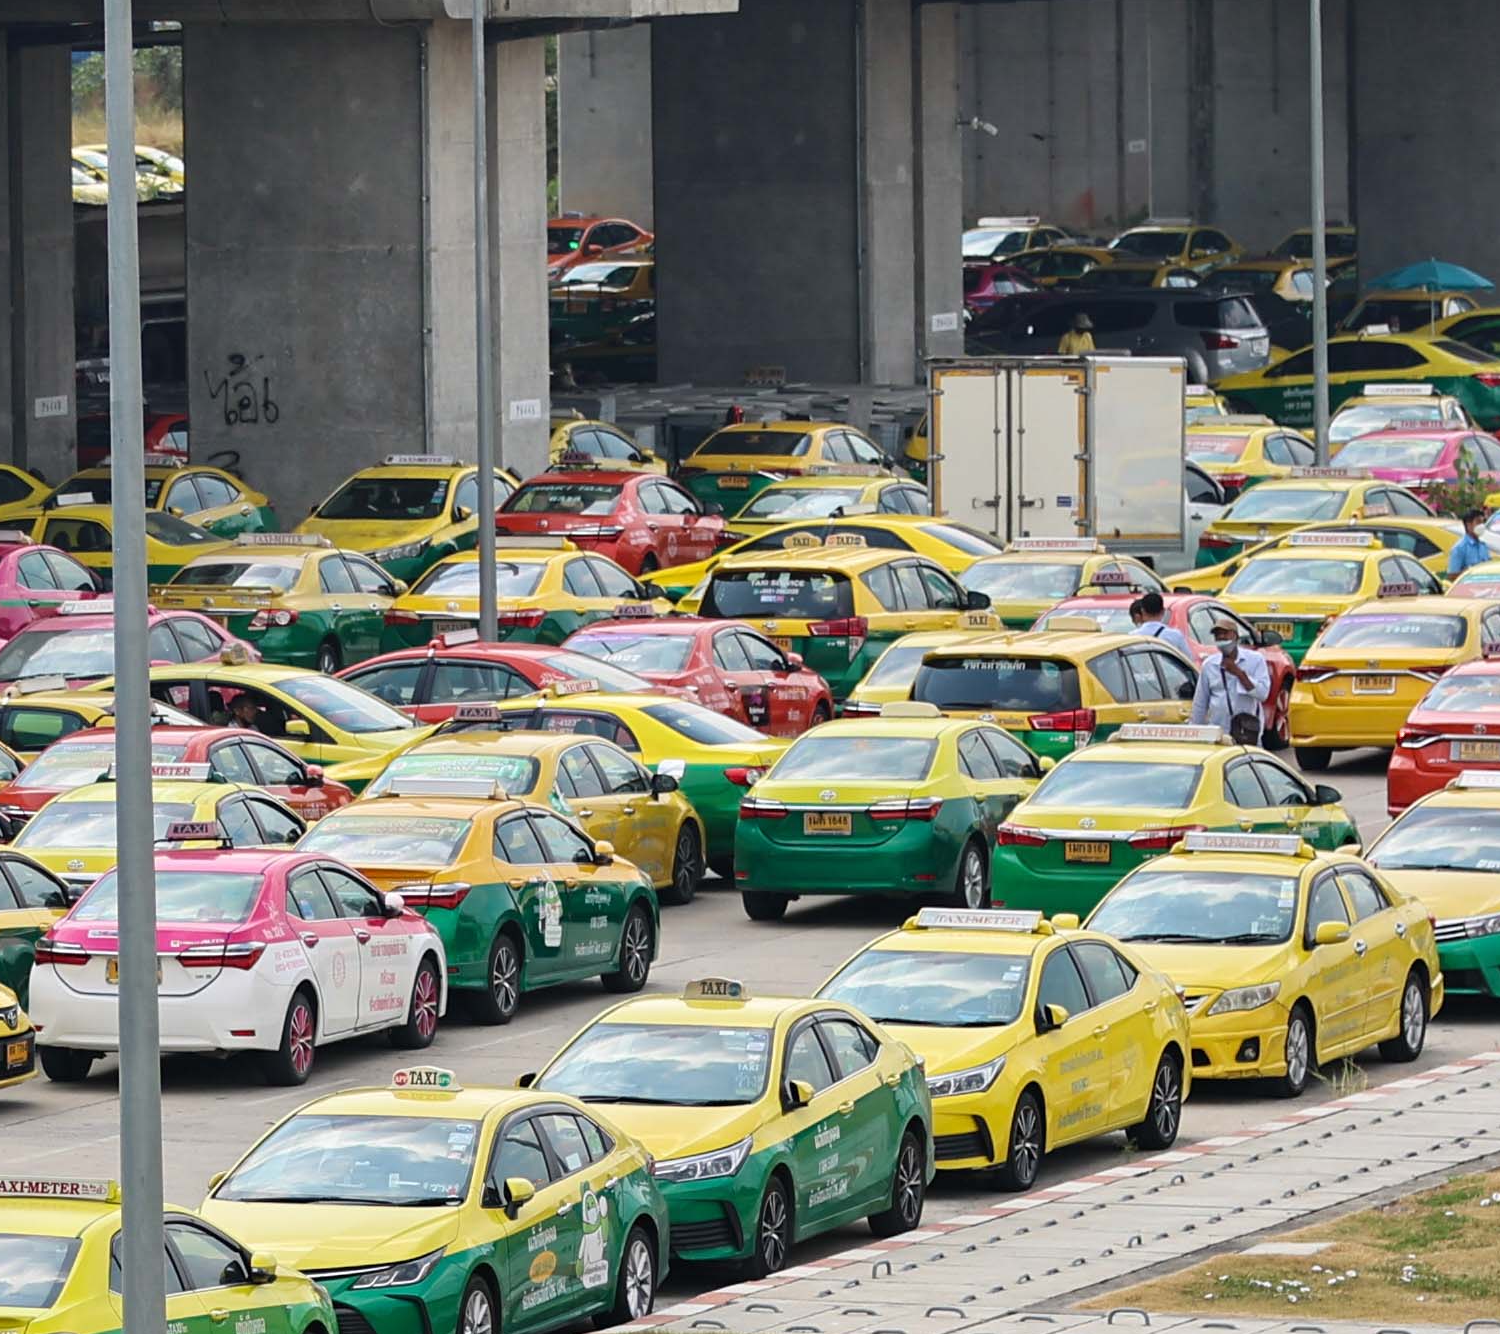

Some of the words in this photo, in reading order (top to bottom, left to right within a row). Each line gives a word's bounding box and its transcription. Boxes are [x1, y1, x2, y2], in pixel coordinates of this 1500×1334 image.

[792, 536, 811, 547] TAXI
[1096, 573, 1125, 582] TAXI
[1382, 584, 1414, 594] TAXI
[619, 606, 648, 614] TAXI
[969, 616, 989, 626] TAXI
[463, 709, 493, 717] TAXI
[172, 824, 209, 835] TAXI
[700, 982, 727, 996] TAXI
[409, 1072, 438, 1086] TAXI
